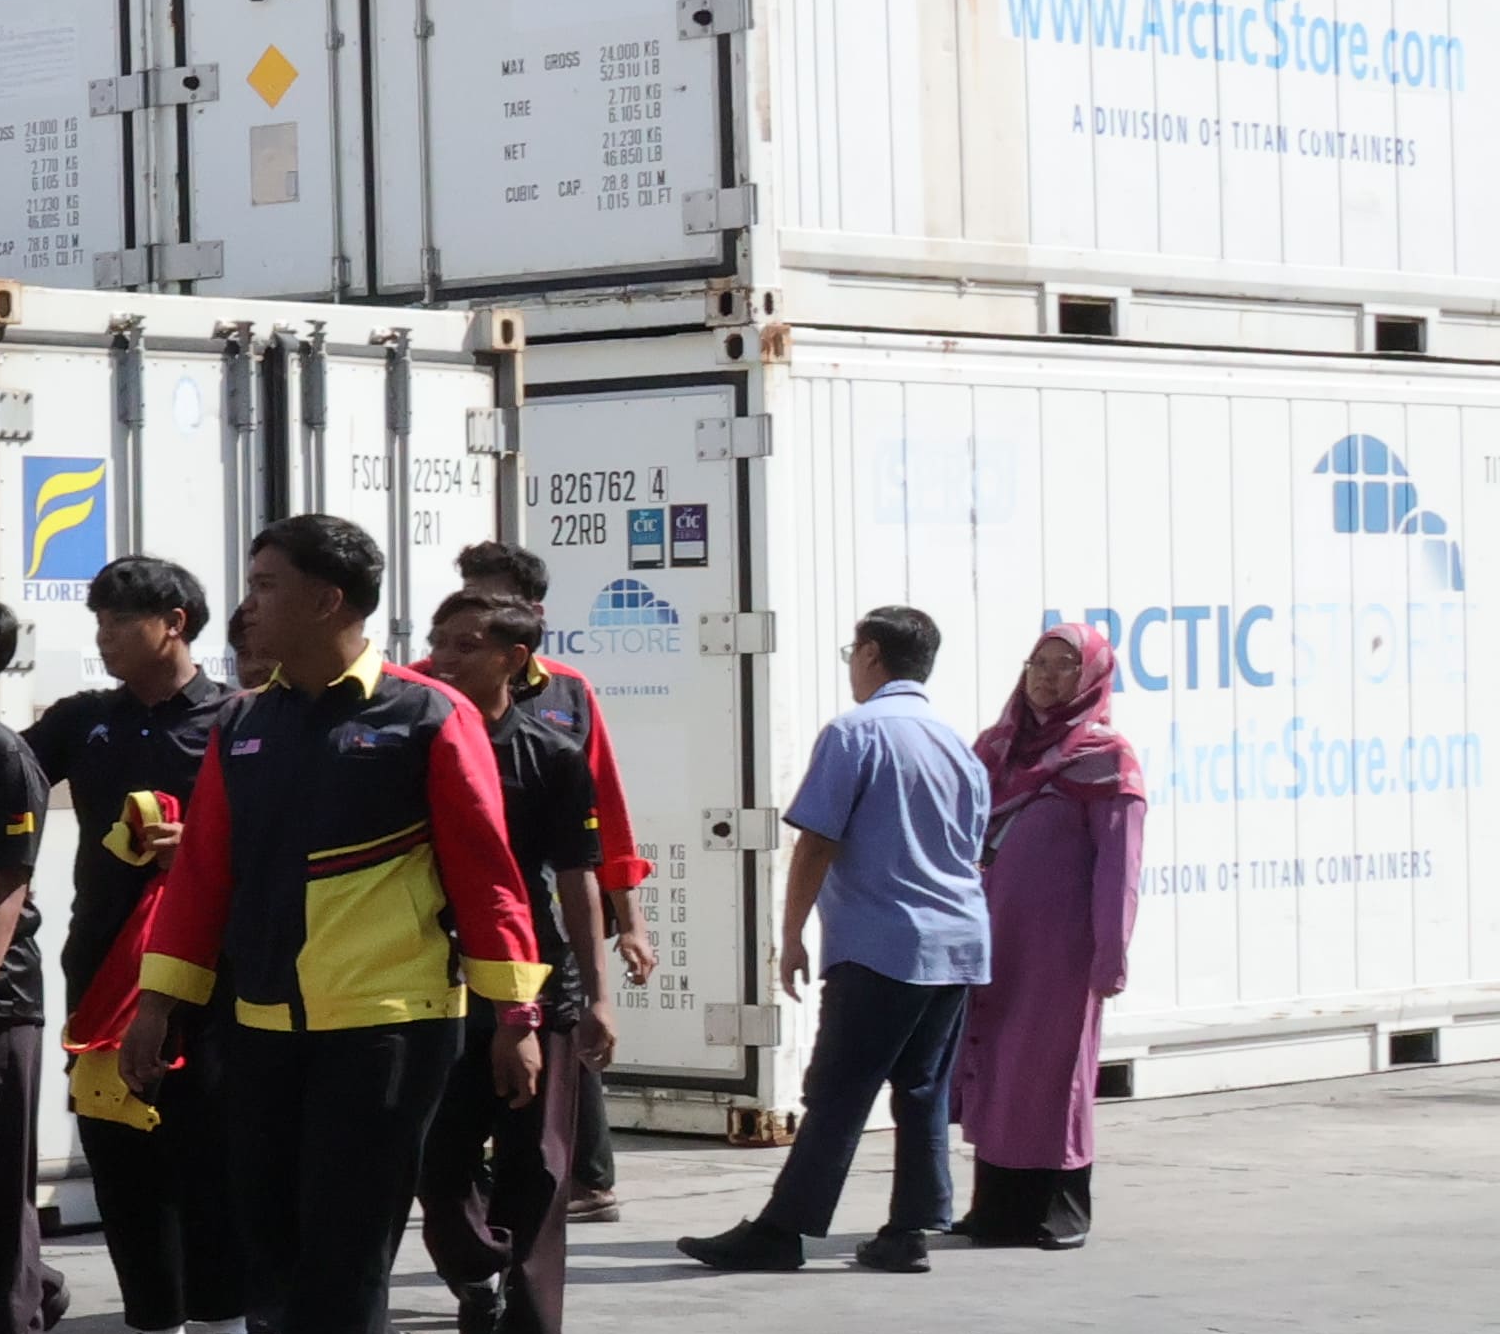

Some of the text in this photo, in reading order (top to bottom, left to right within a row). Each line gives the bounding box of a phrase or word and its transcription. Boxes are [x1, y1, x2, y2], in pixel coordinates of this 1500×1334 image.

[501, 59, 524, 76] MAX
[544, 51, 580, 70] GROSS
[644, 40, 659, 57] KG
[645, 58, 659, 76] LB
[504, 100, 531, 118] TARE
[646, 83, 661, 100] KG
[646, 102, 661, 119] LB
[504, 143, 526, 160] NET
[647, 126, 661, 143] KG
[1073, 105, 1084, 134] A
[1095, 106, 1188, 145] DIVISION
[1232, 121, 1287, 153] TITAN
[1298, 128, 1416, 167] CONTAINERS
[648, 145, 662, 162] LB
[505, 185, 539, 203] CUBIC
[413, 459, 461, 493] 22554
[551, 471, 636, 504] 826762
[652, 469, 664, 500] 4
[551, 513, 606, 545] 22RB
[23, 582, 93, 601] FLORE
[606, 687, 670, 695] CONTAINERS
[1139, 865, 1206, 896] VISION
[1251, 858, 1305, 889] TITAN
[1316, 851, 1432, 885] CONTAINERS
